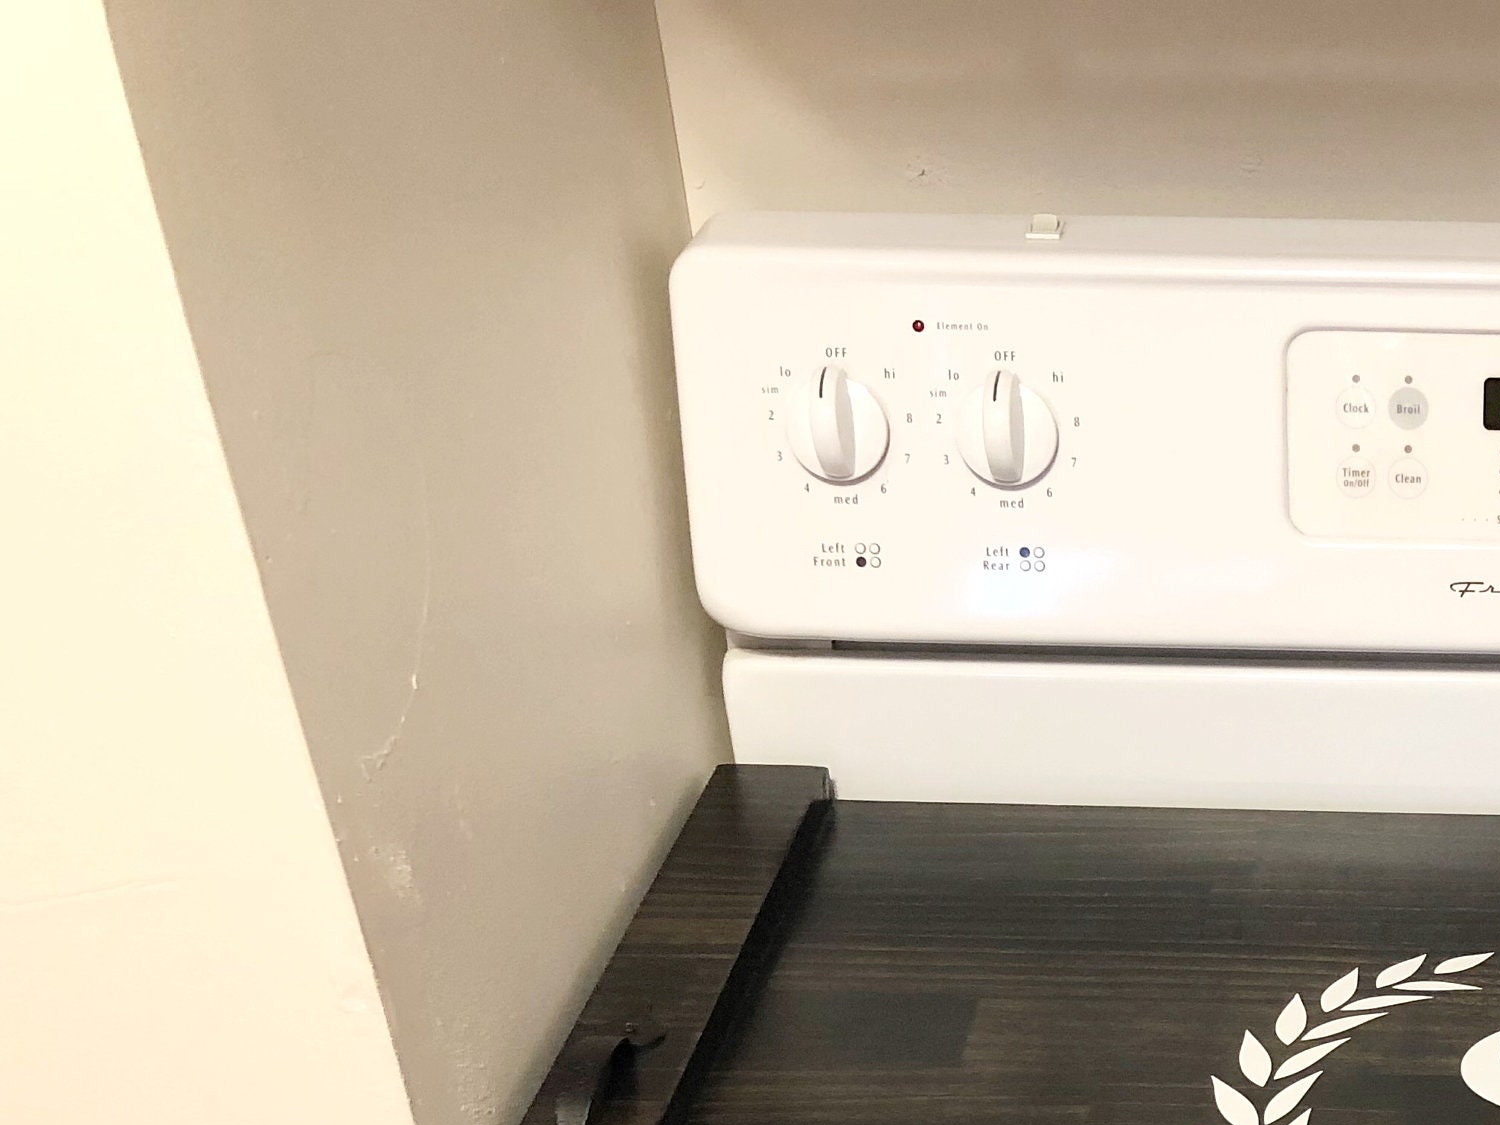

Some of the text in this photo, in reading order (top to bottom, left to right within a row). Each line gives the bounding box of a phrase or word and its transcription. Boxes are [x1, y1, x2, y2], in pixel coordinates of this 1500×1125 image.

[936, 321, 989, 331] Element On
[825, 347, 847, 358] OFF
[993, 350, 1016, 362] OFF
[779, 365, 792, 378] lo
[883, 367, 896, 379] hi
[948, 368, 960, 381] lo
[1052, 371, 1064, 383] hi
[761, 386, 779, 394] sim
[929, 390, 947, 398] sim
[1342, 402, 1369, 414] Clock
[1396, 403, 1421, 415] Broil
[768, 410, 775, 420] 2
[906, 413, 913, 423] 8
[935, 414, 943, 424] 2
[1073, 417, 1081, 427] 8
[776, 451, 783, 461] 3
[904, 453, 911, 463] 7
[943, 455, 950, 464] 3
[1071, 457, 1077, 467] 7
[1342, 467, 1371, 478] Timer
[1343, 478, 1370, 488] On/Off
[1394, 473, 1422, 484] Clean
[804, 483, 810, 492] 4
[880, 484, 887, 494] 6
[970, 488, 976, 496] 4
[1046, 488, 1053, 497] 6
[833, 493, 859, 505] med
[999, 497, 1025, 509] med
[821, 542, 845, 554] Left
[985, 546, 1009, 557] Left
[812, 556, 846, 567] Front
[982, 560, 1010, 571] Rear
